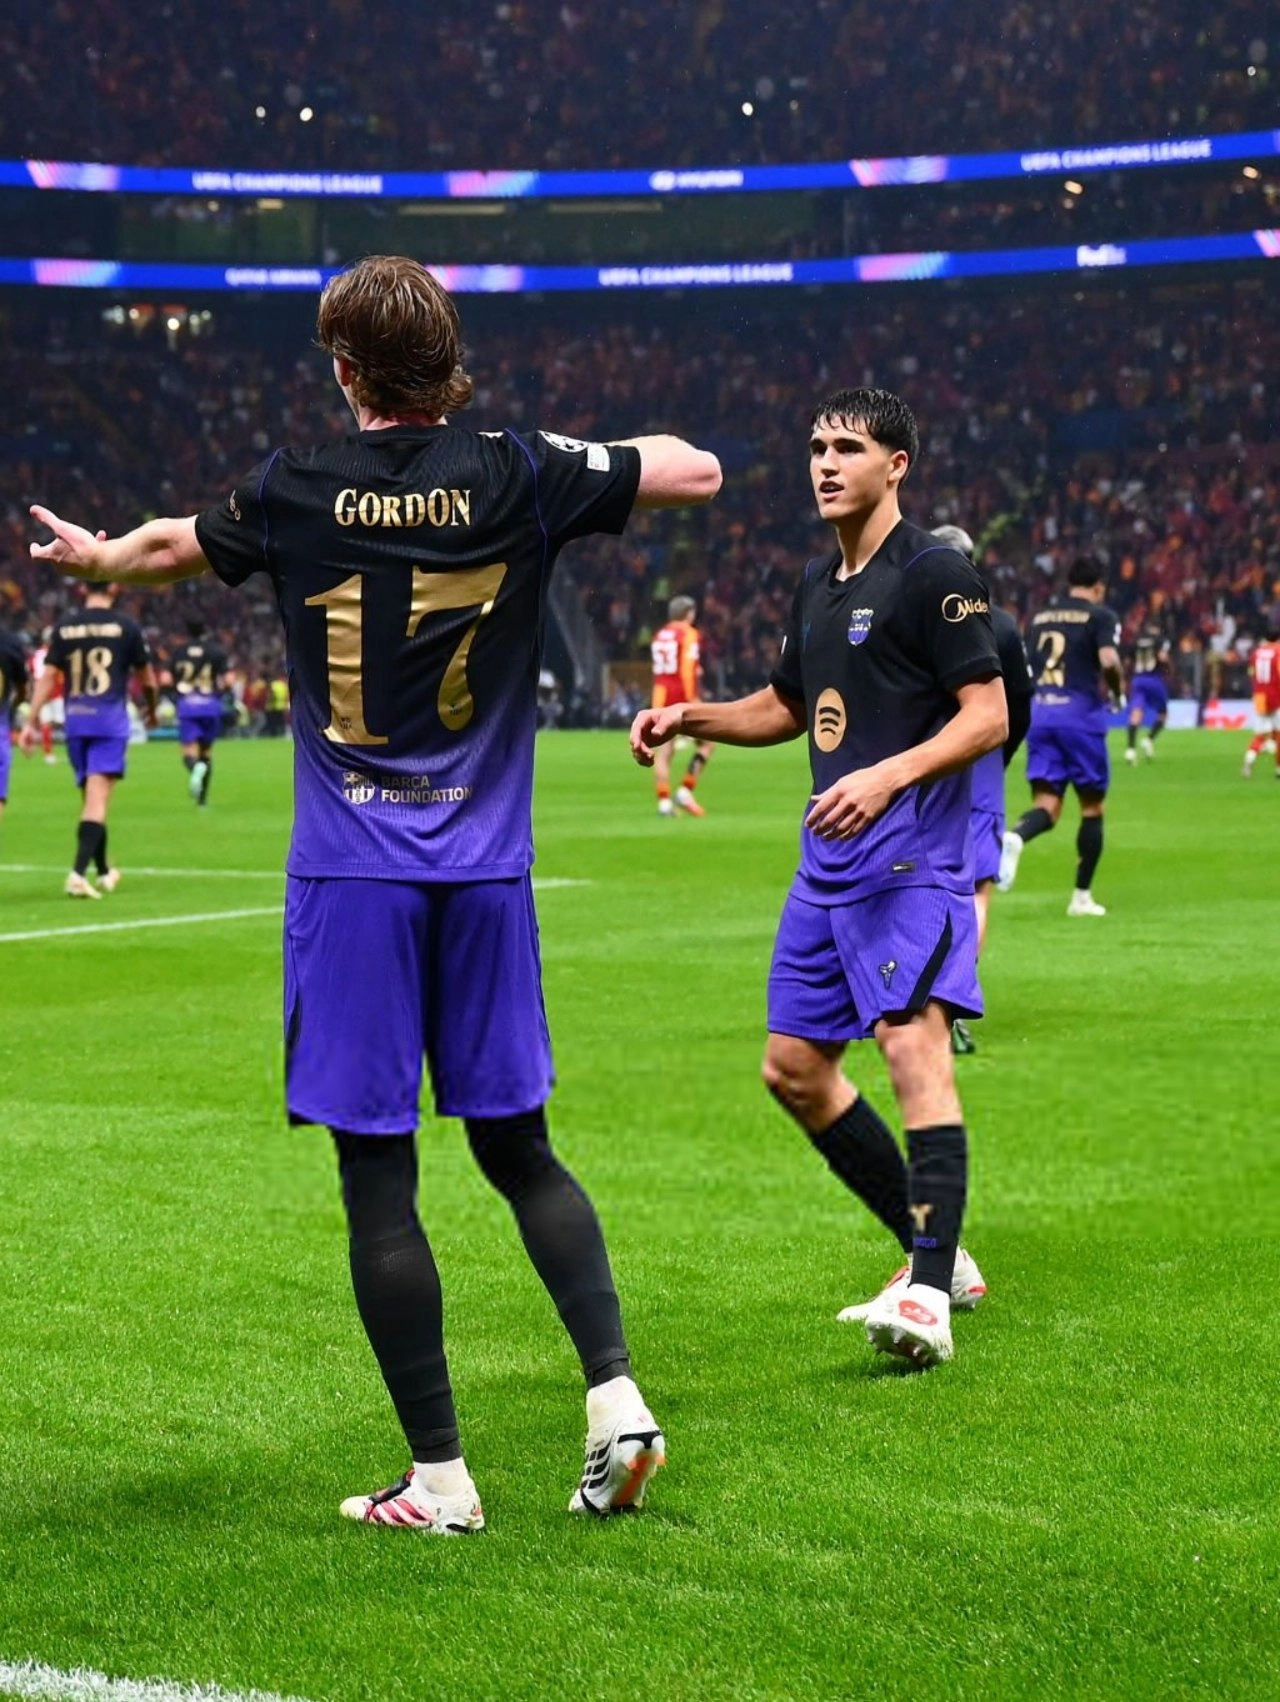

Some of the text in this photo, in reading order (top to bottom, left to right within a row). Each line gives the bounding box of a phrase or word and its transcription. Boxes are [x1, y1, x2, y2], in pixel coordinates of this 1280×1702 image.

[1020, 138, 1212, 172] UEFA CHAMPIONS LEAGUE
[192, 171, 384, 195] UEFA CHAMPIONS LEAGUE
[598, 262, 794, 286] UEFA CHAMPIONS LEAGUE
[334, 488, 471, 527] GORDON
[945, 595, 990, 621] Mide
[66, 645, 112, 697] 18
[304, 562, 508, 746] 17
[1037, 630, 1066, 688] 2
[175, 660, 213, 695] 24
[381, 775, 431, 791] BARÇA
[381, 786, 472, 804] FOUNDATION
